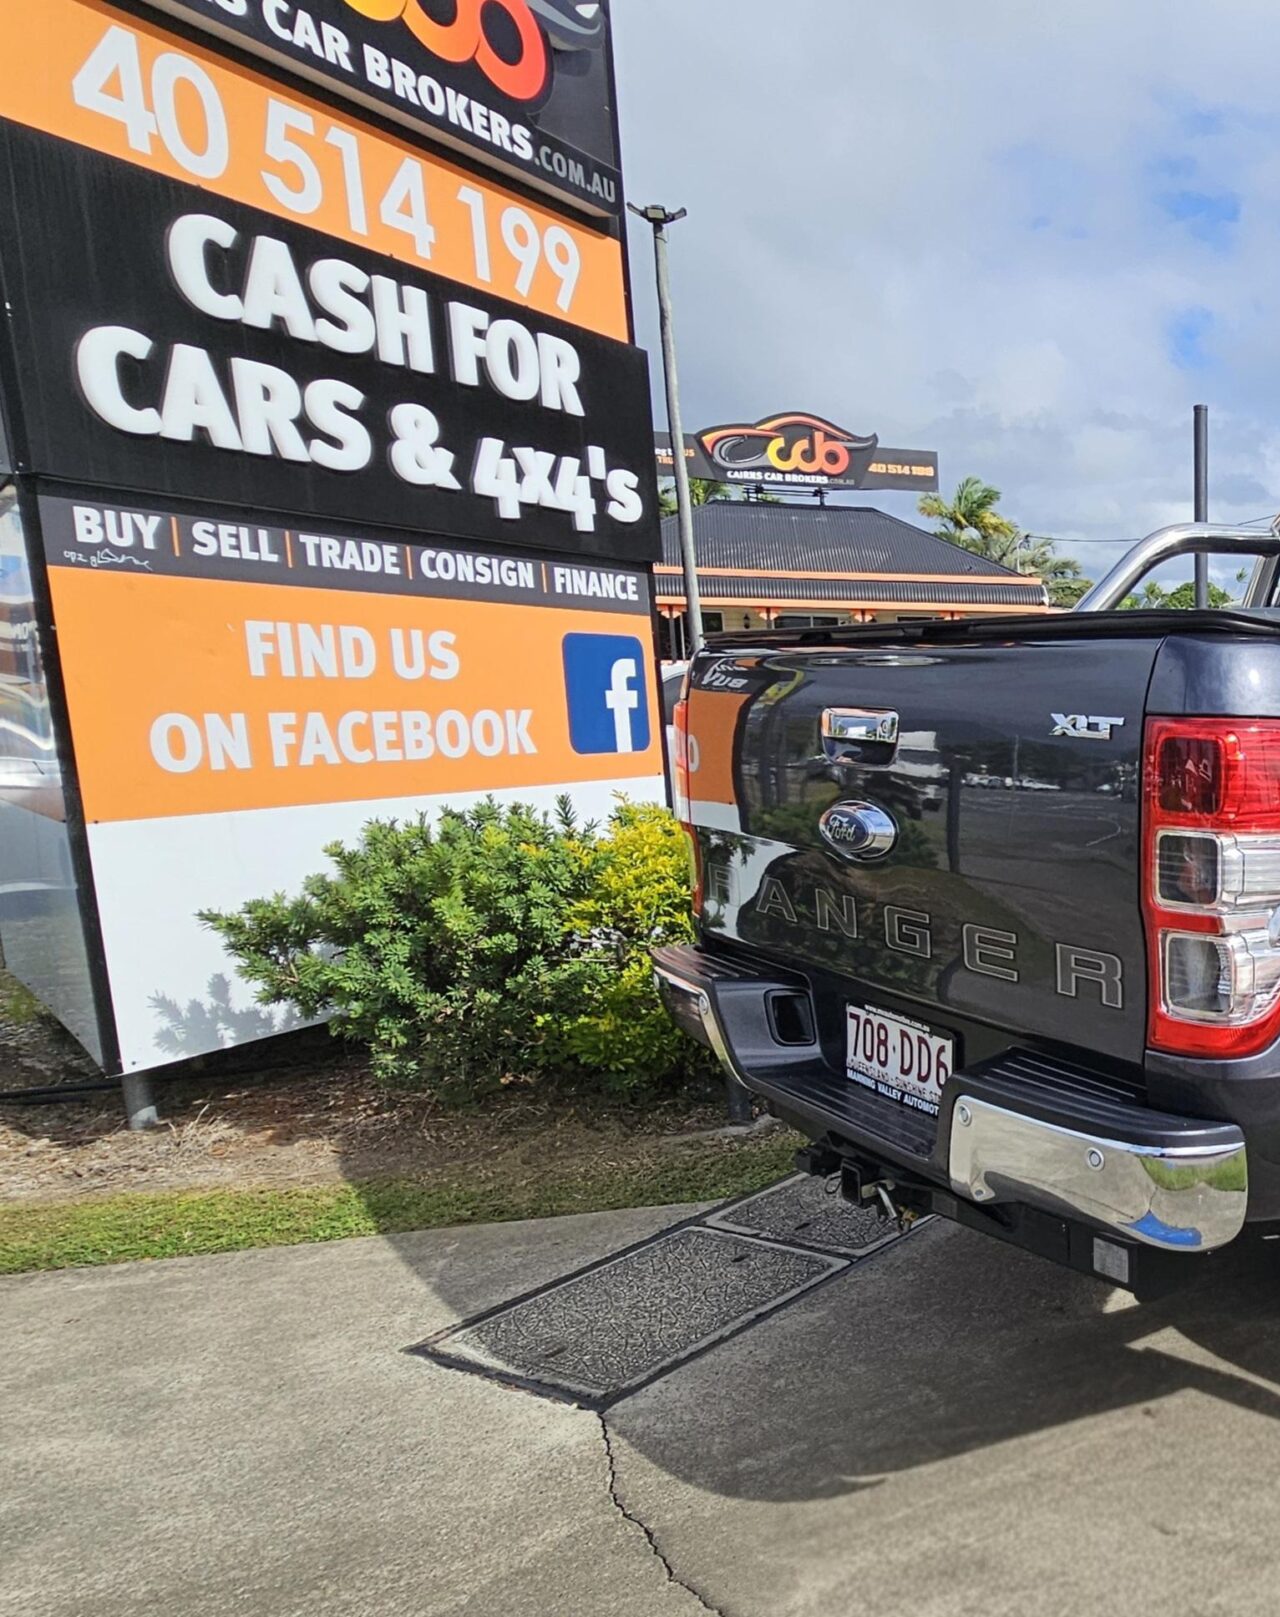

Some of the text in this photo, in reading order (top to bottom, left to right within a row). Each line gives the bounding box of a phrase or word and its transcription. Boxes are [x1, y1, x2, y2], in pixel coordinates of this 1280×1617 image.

[262, 0, 355, 74] CAR
[72, 24, 229, 180] 40
[260, 98, 436, 260] 514
[457, 184, 581, 313] 199
[166, 213, 585, 417] CASH FOR
[76, 326, 372, 472] CARS
[389, 403, 462, 490] &
[727, 470, 763, 480] CAIRNS
[764, 472, 784, 482] CAR
[868, 462, 886, 473] 40
[73, 506, 162, 550] BUY
[192, 520, 280, 565] SELL
[300, 533, 401, 577] TRADE
[420, 549, 536, 590] CONSIGN
[554, 566, 640, 602] FINANCE
[244, 619, 460, 681] FIND US
[149, 708, 538, 775] ON FACEBOOK
[1048, 713, 1125, 740] XLT
[827, 814, 857, 843] Ford
[707, 862, 1123, 1010] RANGER
[877, 1081, 902, 1101] VALLEY
